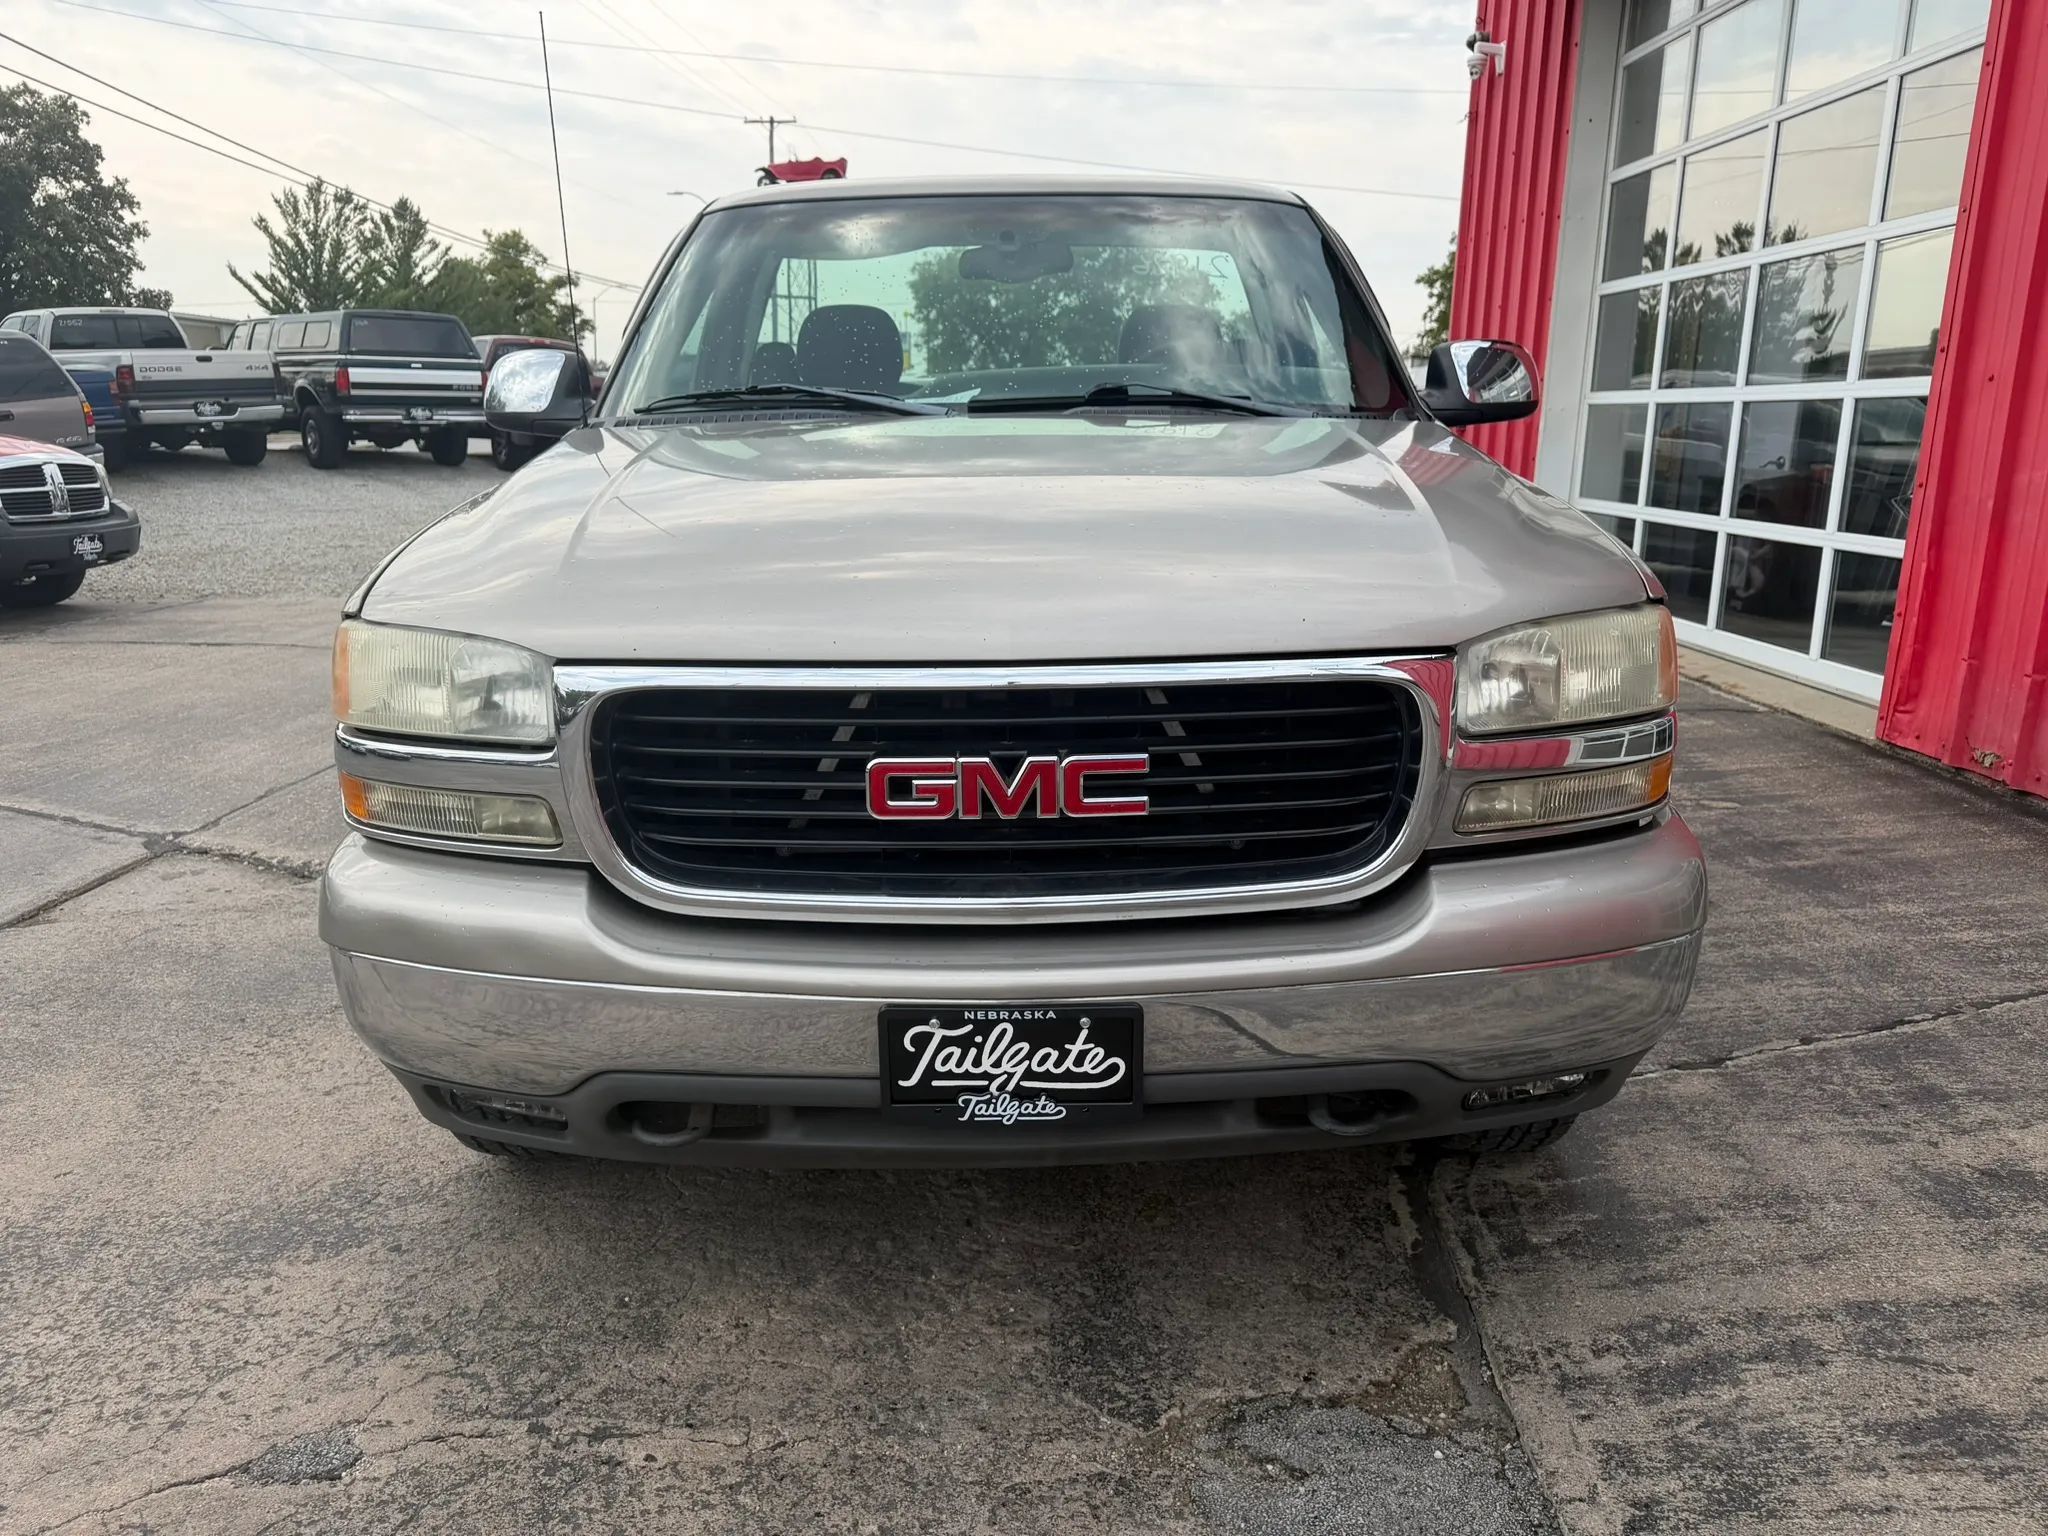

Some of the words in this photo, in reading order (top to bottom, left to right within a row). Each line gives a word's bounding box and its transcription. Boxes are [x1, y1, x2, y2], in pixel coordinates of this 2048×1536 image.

[866, 754, 1149, 820] GMC
[964, 1010, 1057, 1020] NEBRASKA
[898, 1021, 1127, 1095] Tailgate
[958, 1093, 1067, 1125] Tailgate
